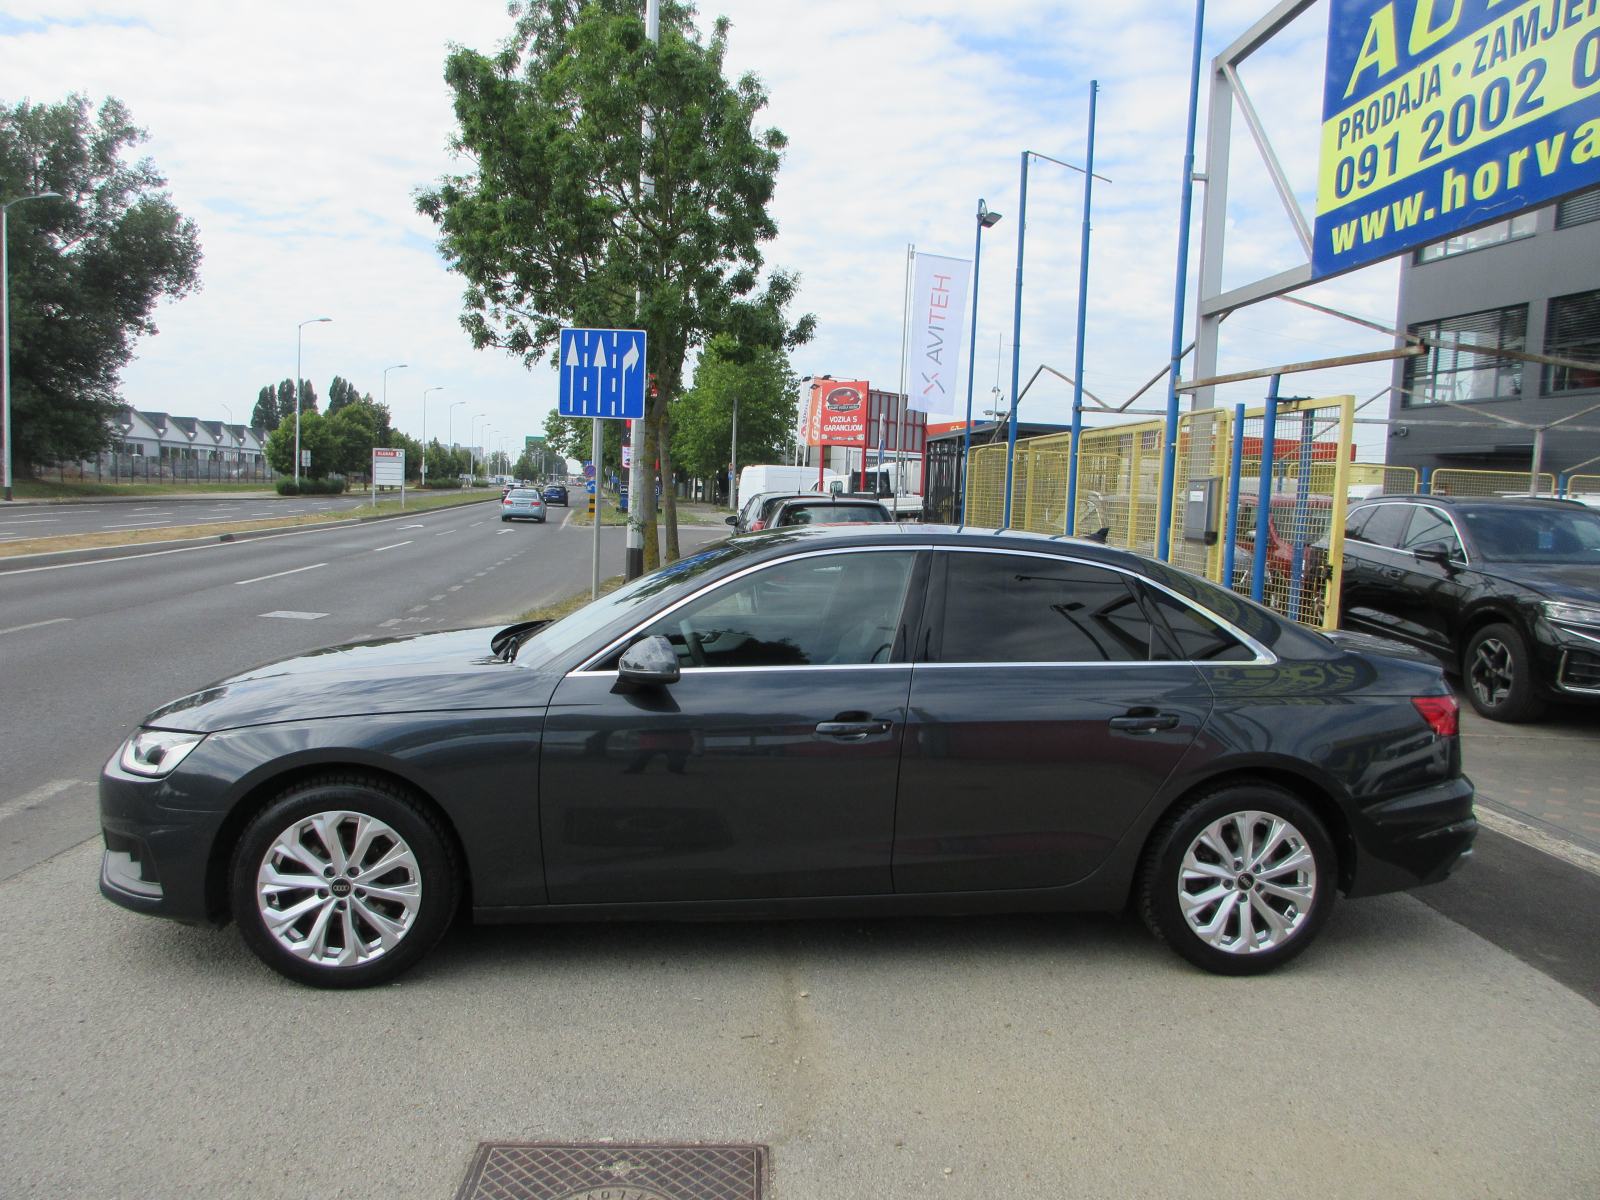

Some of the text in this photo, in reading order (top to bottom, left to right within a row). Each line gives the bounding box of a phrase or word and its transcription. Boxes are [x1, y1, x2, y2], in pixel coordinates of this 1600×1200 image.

[1343, 0, 1510, 99] AU
[1335, 131, 1400, 199] 091
[1418, 57, 1548, 163] 2002
[1337, 63, 1441, 151] PRODAJA
[926, 274, 952, 366] AVITEH
[823, 424, 863, 432] GARANCIJOM
[829, 415, 858, 423] VOZILA S
